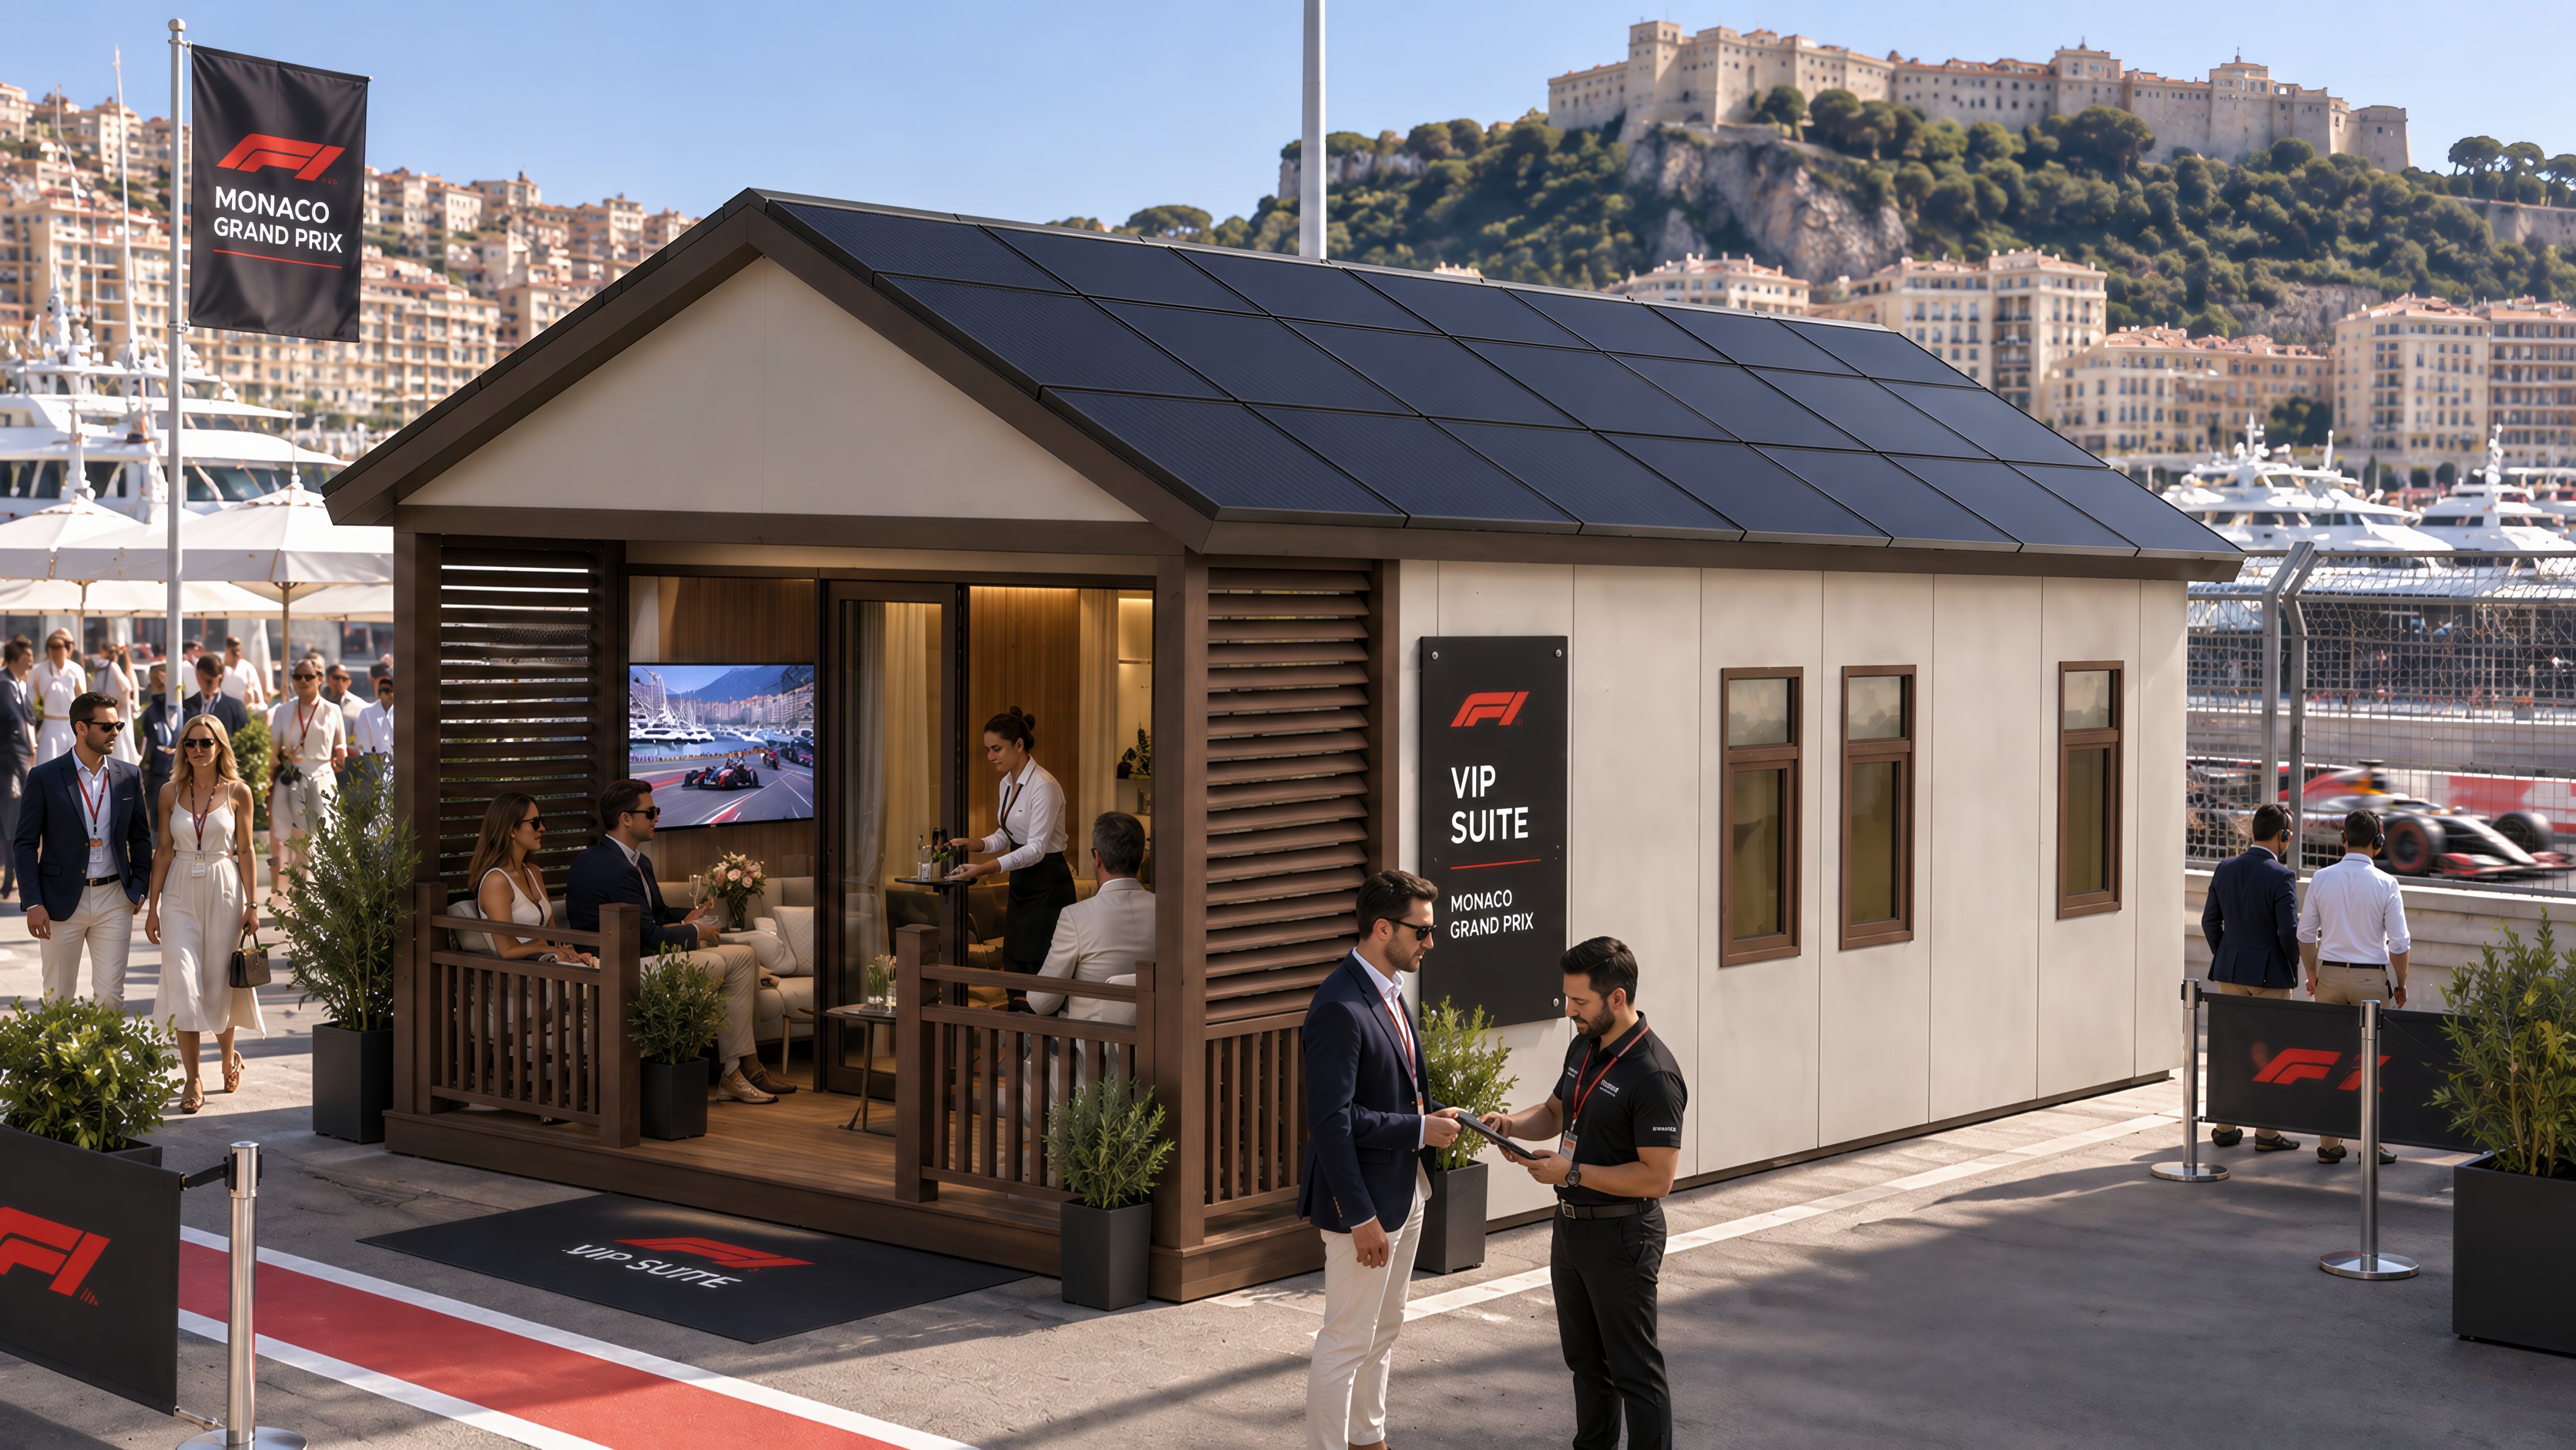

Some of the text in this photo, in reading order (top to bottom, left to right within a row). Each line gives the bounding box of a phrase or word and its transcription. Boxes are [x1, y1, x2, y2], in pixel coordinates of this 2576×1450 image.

[214, 186, 330, 225] MONACO
[213, 216, 344, 254] GRAND PRIX
[1451, 764, 1497, 799] VIP
[1451, 806, 1530, 844] SUITE
[1451, 889, 1513, 913] MONACO
[1450, 911, 1535, 939] GRAND PRIX
[566, 1244, 743, 1288] VIP SUITE
